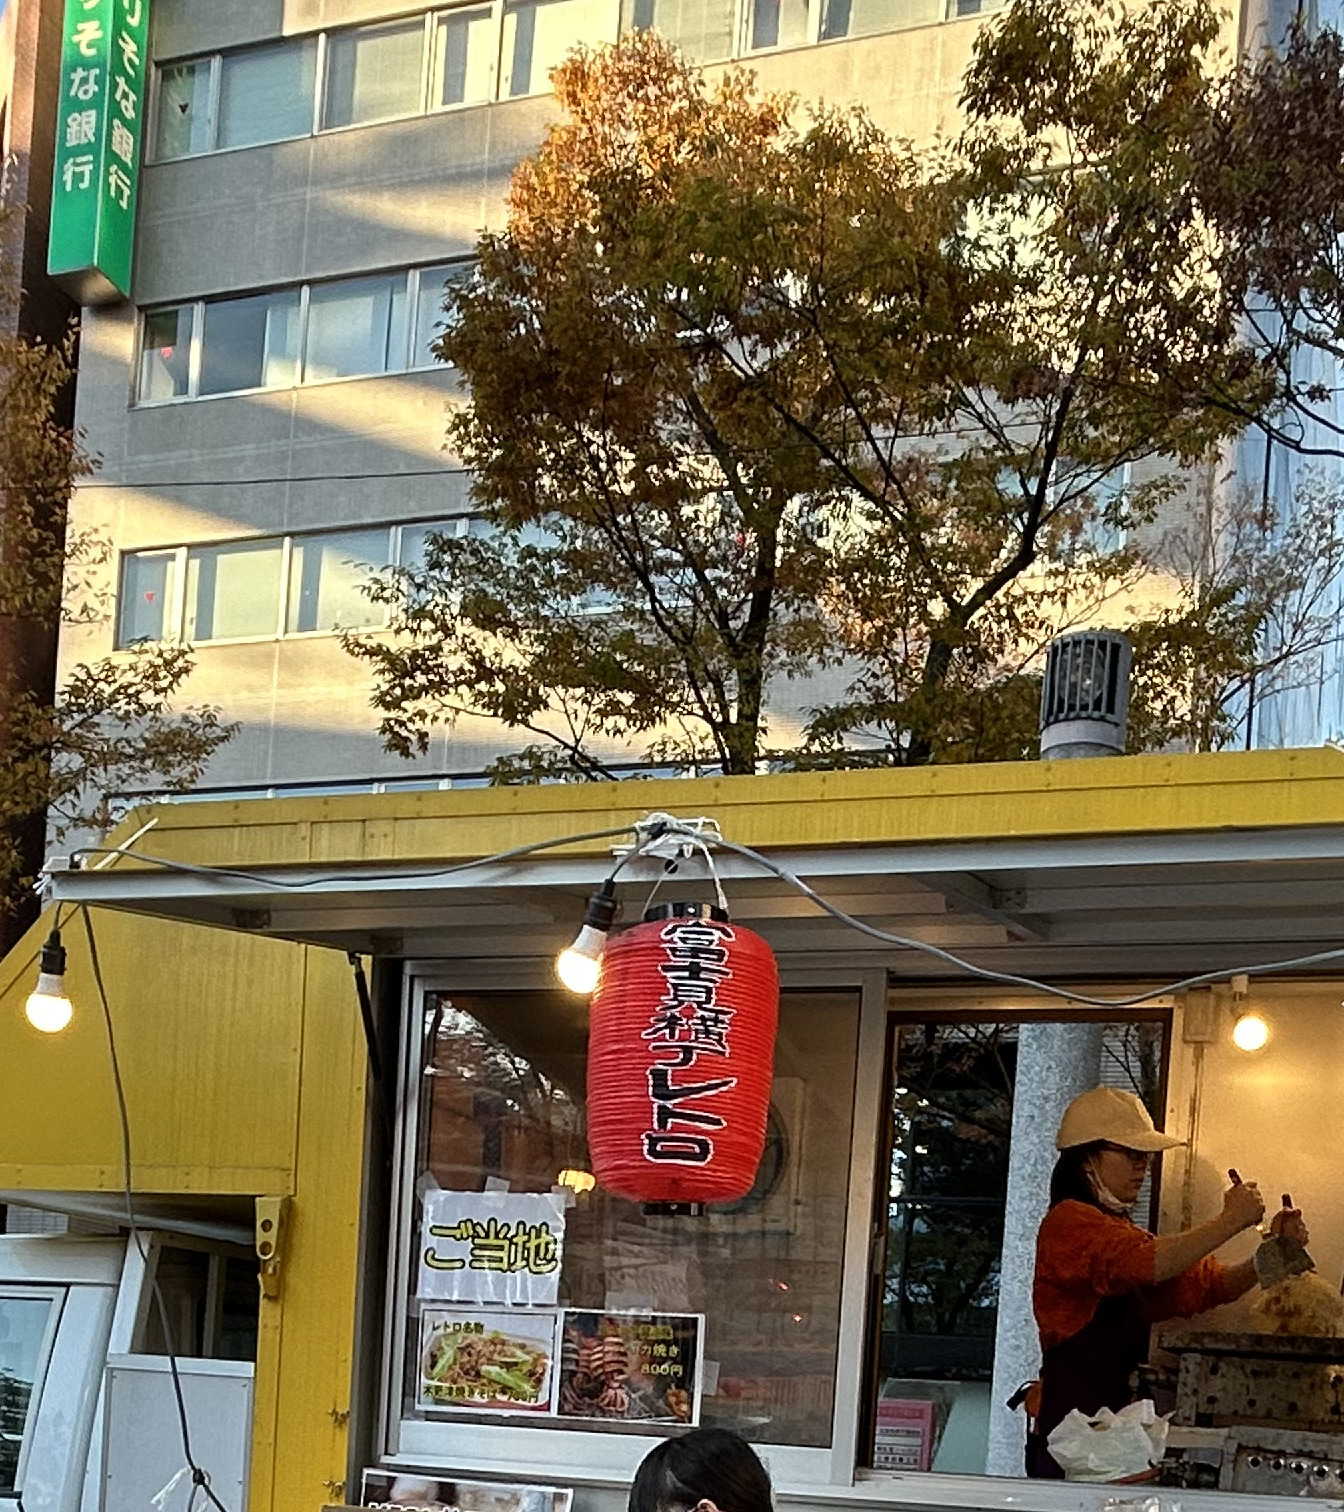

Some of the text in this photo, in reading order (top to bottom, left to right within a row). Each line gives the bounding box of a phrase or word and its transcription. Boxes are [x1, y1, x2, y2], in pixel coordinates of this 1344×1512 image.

[62, 0, 103, 192] そな銀行
[425, 1217, 559, 1275] ご当地
